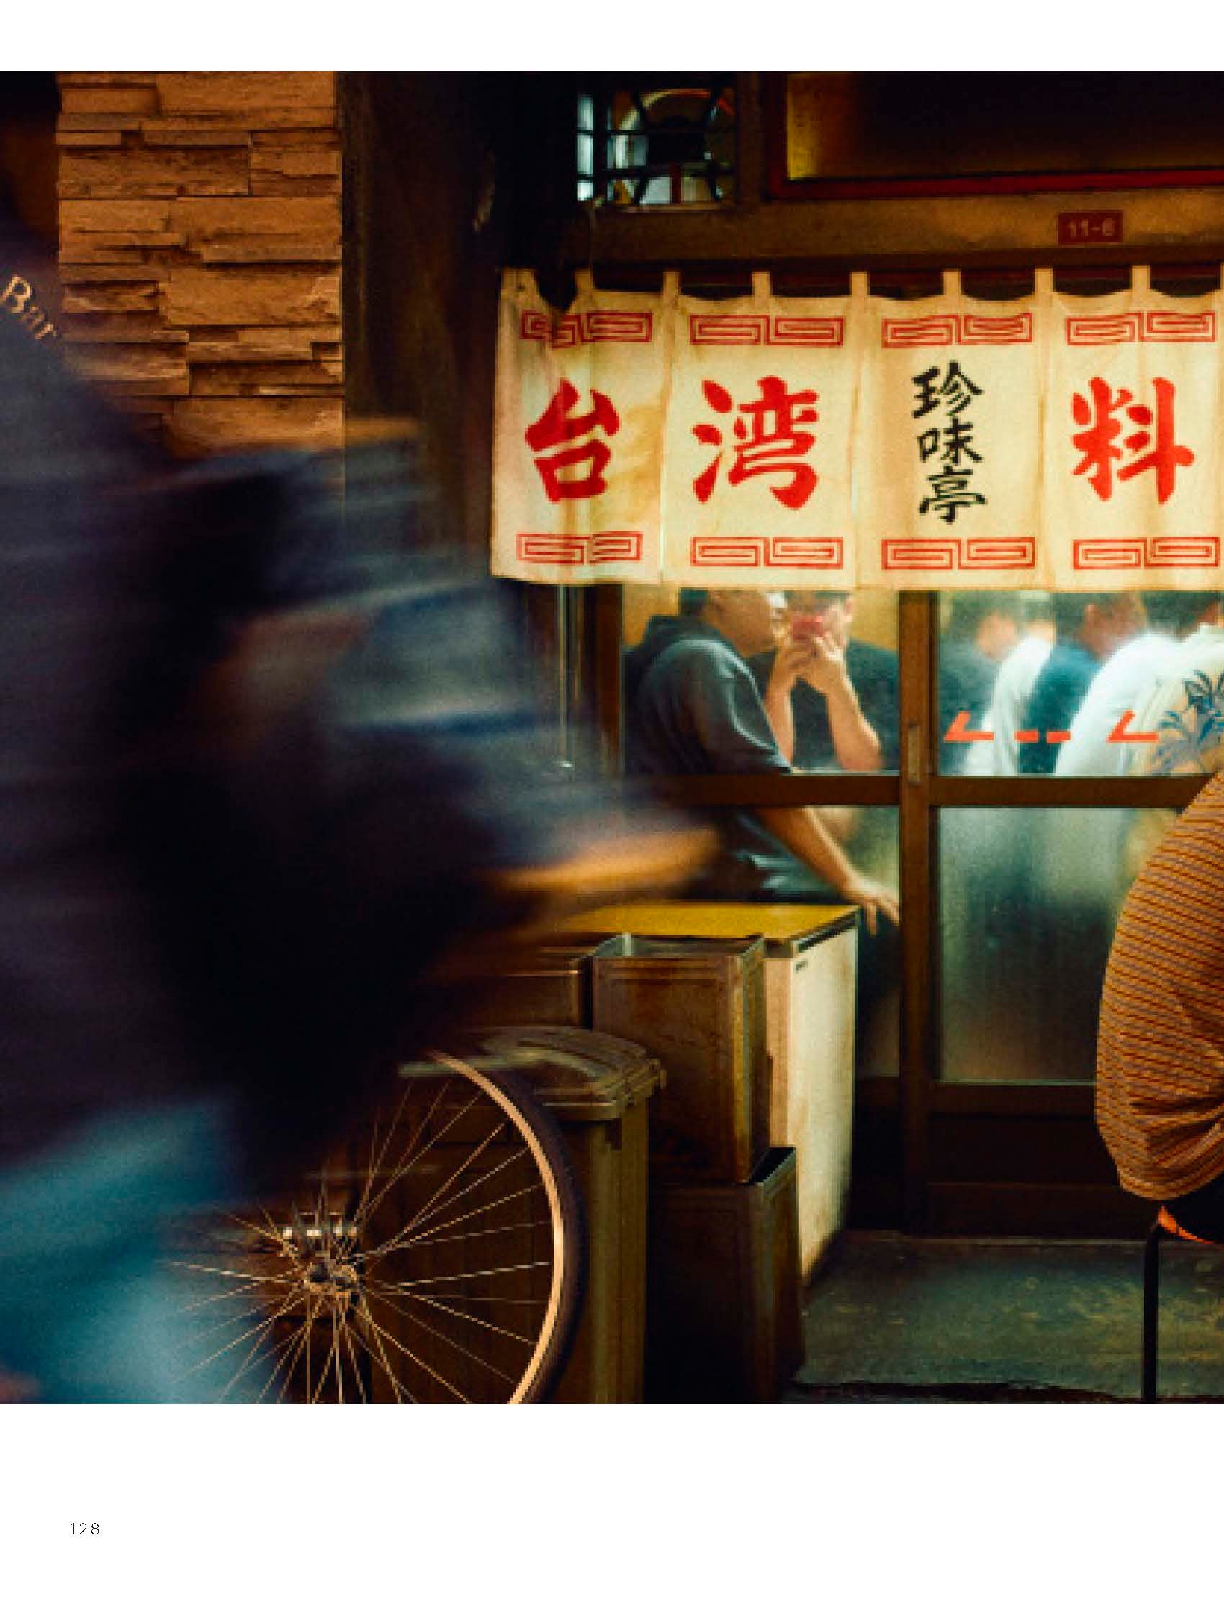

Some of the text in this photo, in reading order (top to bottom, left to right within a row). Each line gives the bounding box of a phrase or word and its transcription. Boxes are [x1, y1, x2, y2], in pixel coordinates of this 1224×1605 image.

[0, 275, 57, 340] Bar
[912, 362, 987, 524] 珍味亭
